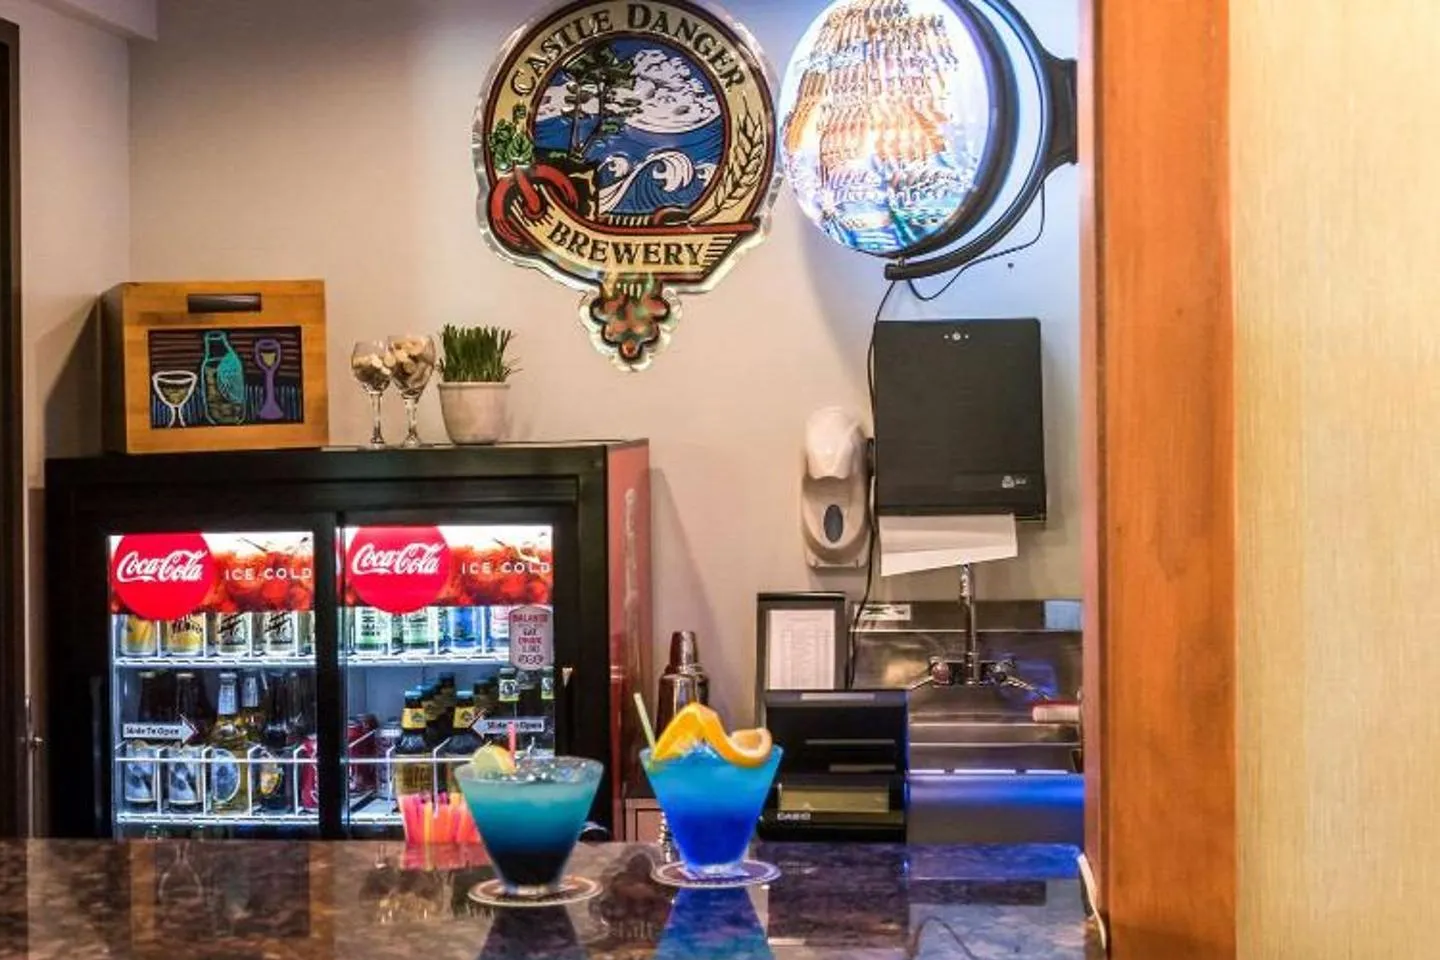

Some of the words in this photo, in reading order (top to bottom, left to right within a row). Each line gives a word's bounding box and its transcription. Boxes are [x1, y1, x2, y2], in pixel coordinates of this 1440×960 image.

[511, 13, 614, 97] CASTLE
[627, 4, 745, 90] DANGER
[546, 220, 706, 266] BREWERY
[116, 550, 208, 583] Coca-Cola
[225, 569, 254, 580] ICE
[264, 567, 312, 579] COLD
[352, 542, 446, 574] Coca-Cola
[462, 563, 490, 575] ICE
[501, 561, 550, 574] COLD
